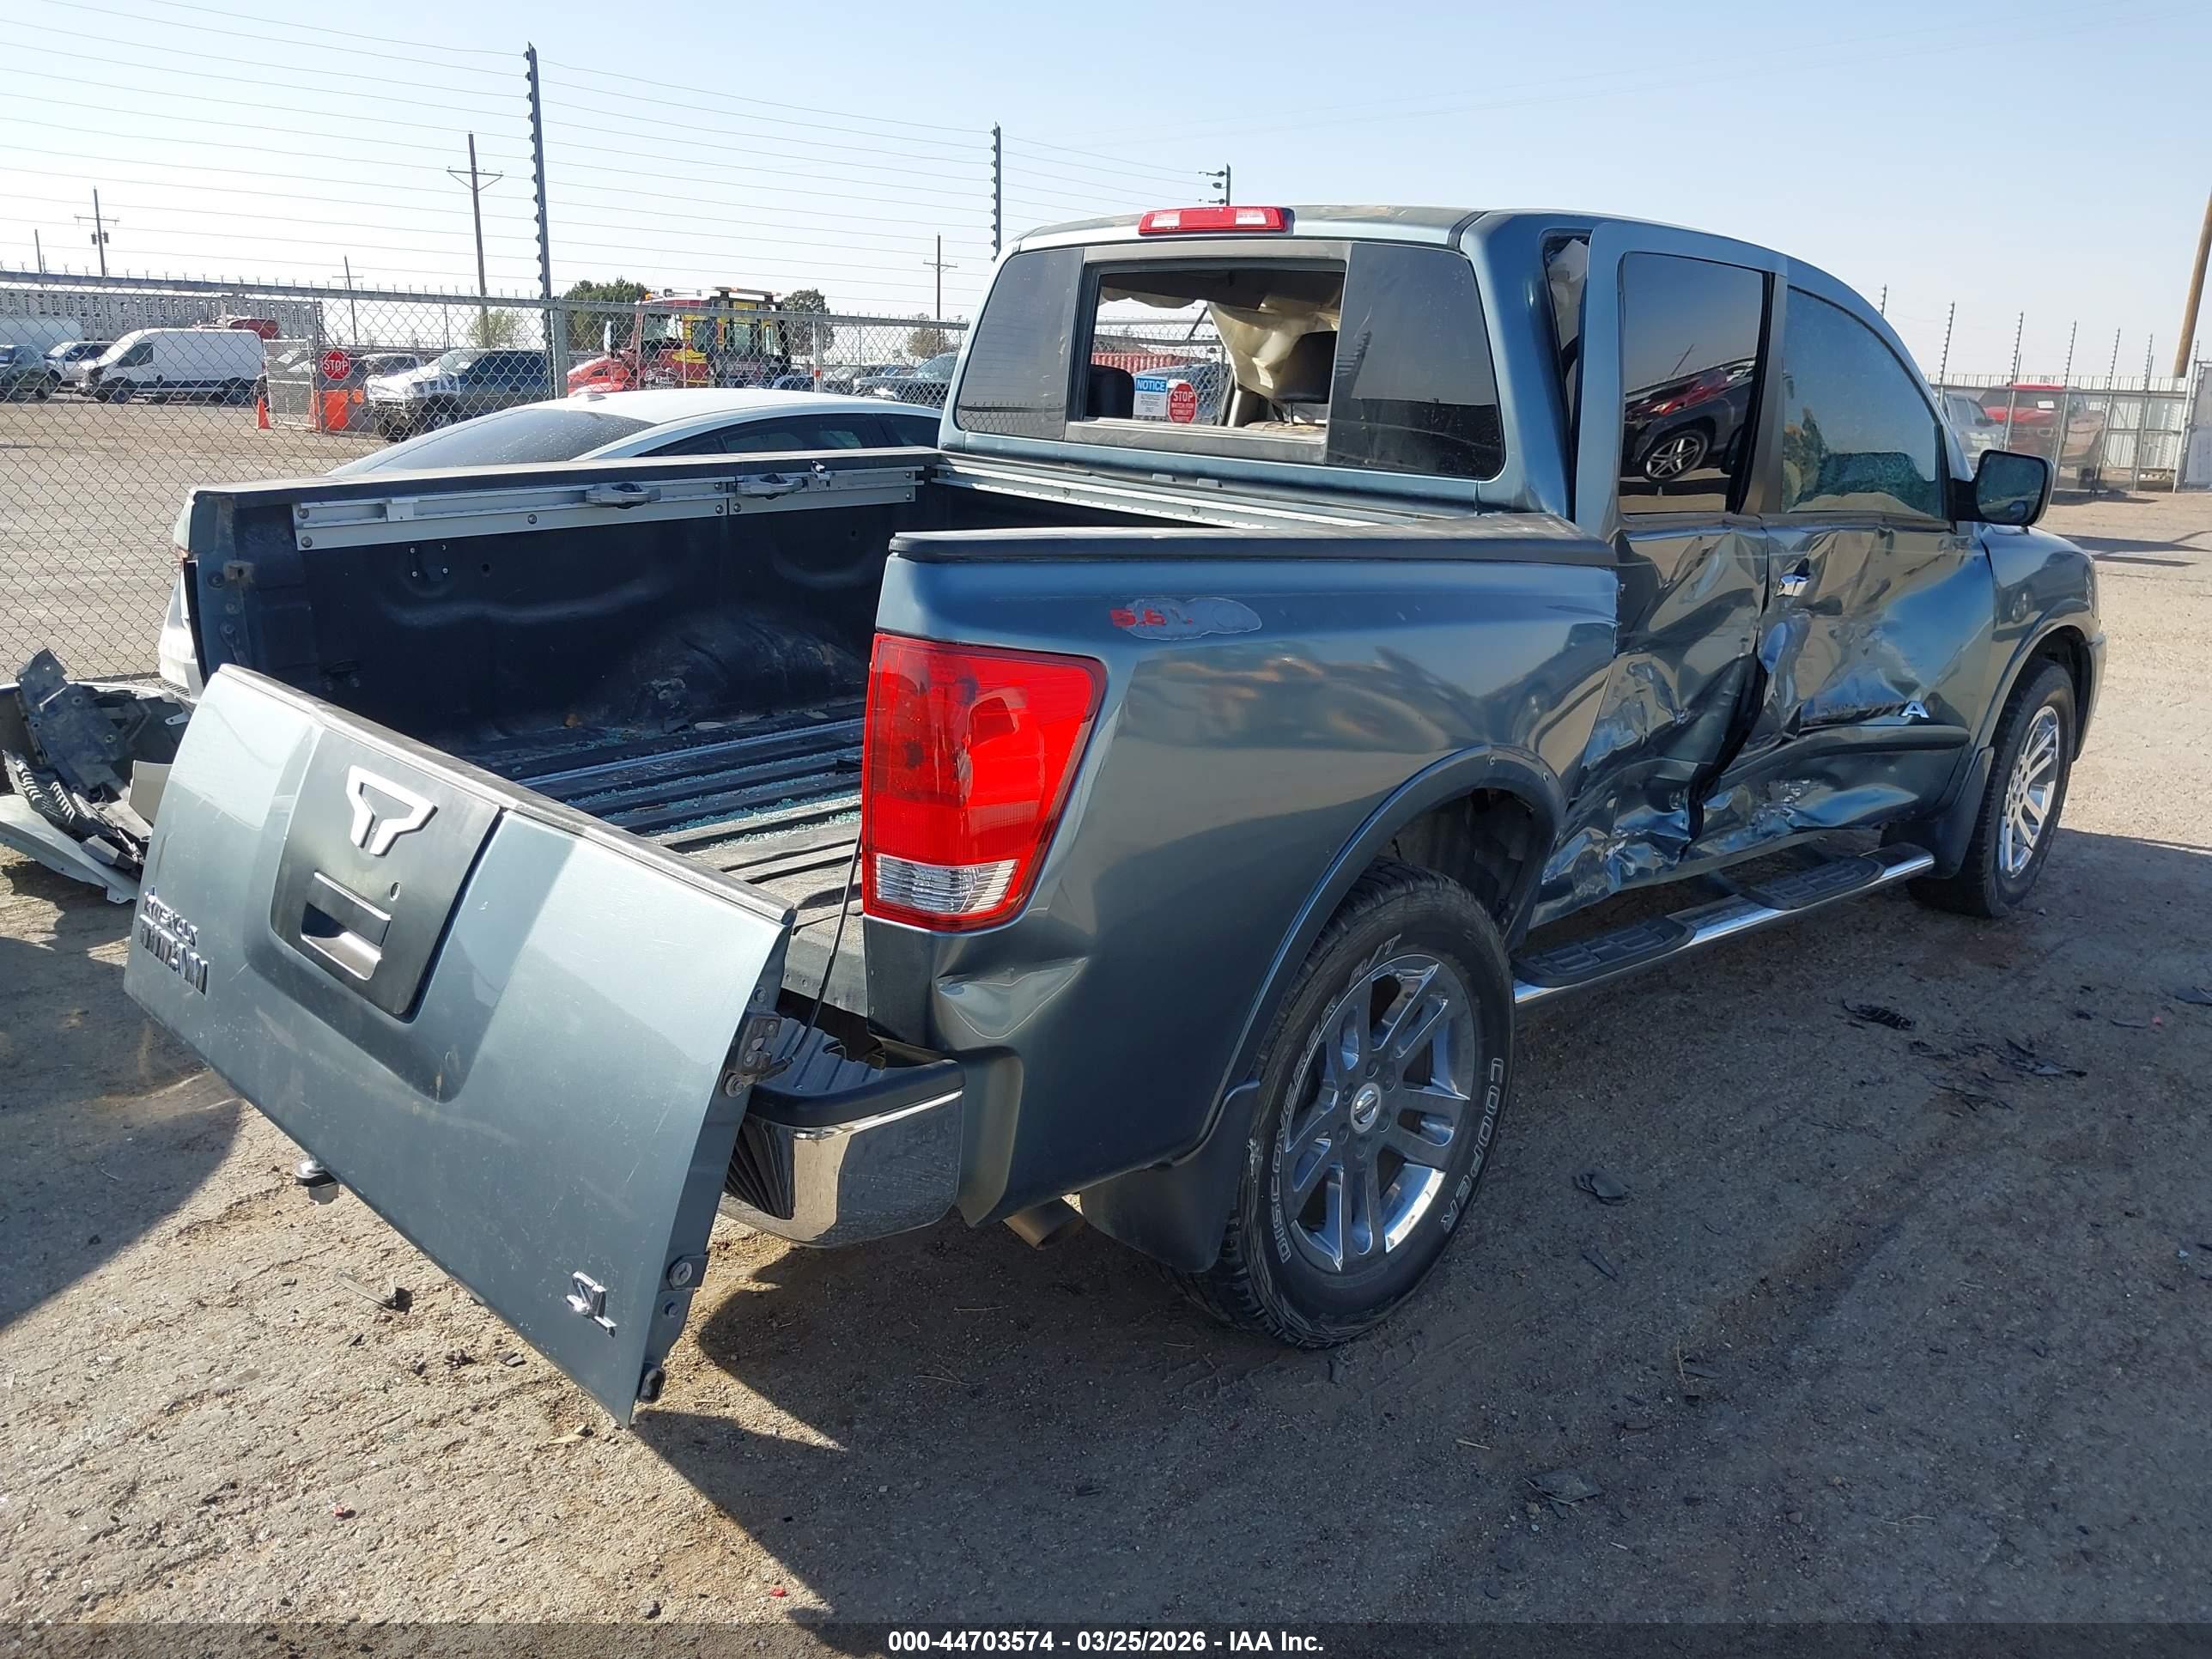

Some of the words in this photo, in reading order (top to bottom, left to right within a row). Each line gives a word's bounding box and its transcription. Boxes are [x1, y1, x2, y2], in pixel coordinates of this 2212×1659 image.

[324, 359, 348, 372] STOP
[1137, 379, 1165, 392] NOTICE
[1173, 391, 1194, 402] STOP
[139, 914, 209, 997] TITAN
[1438, 1057, 1504, 1234] COOPER
